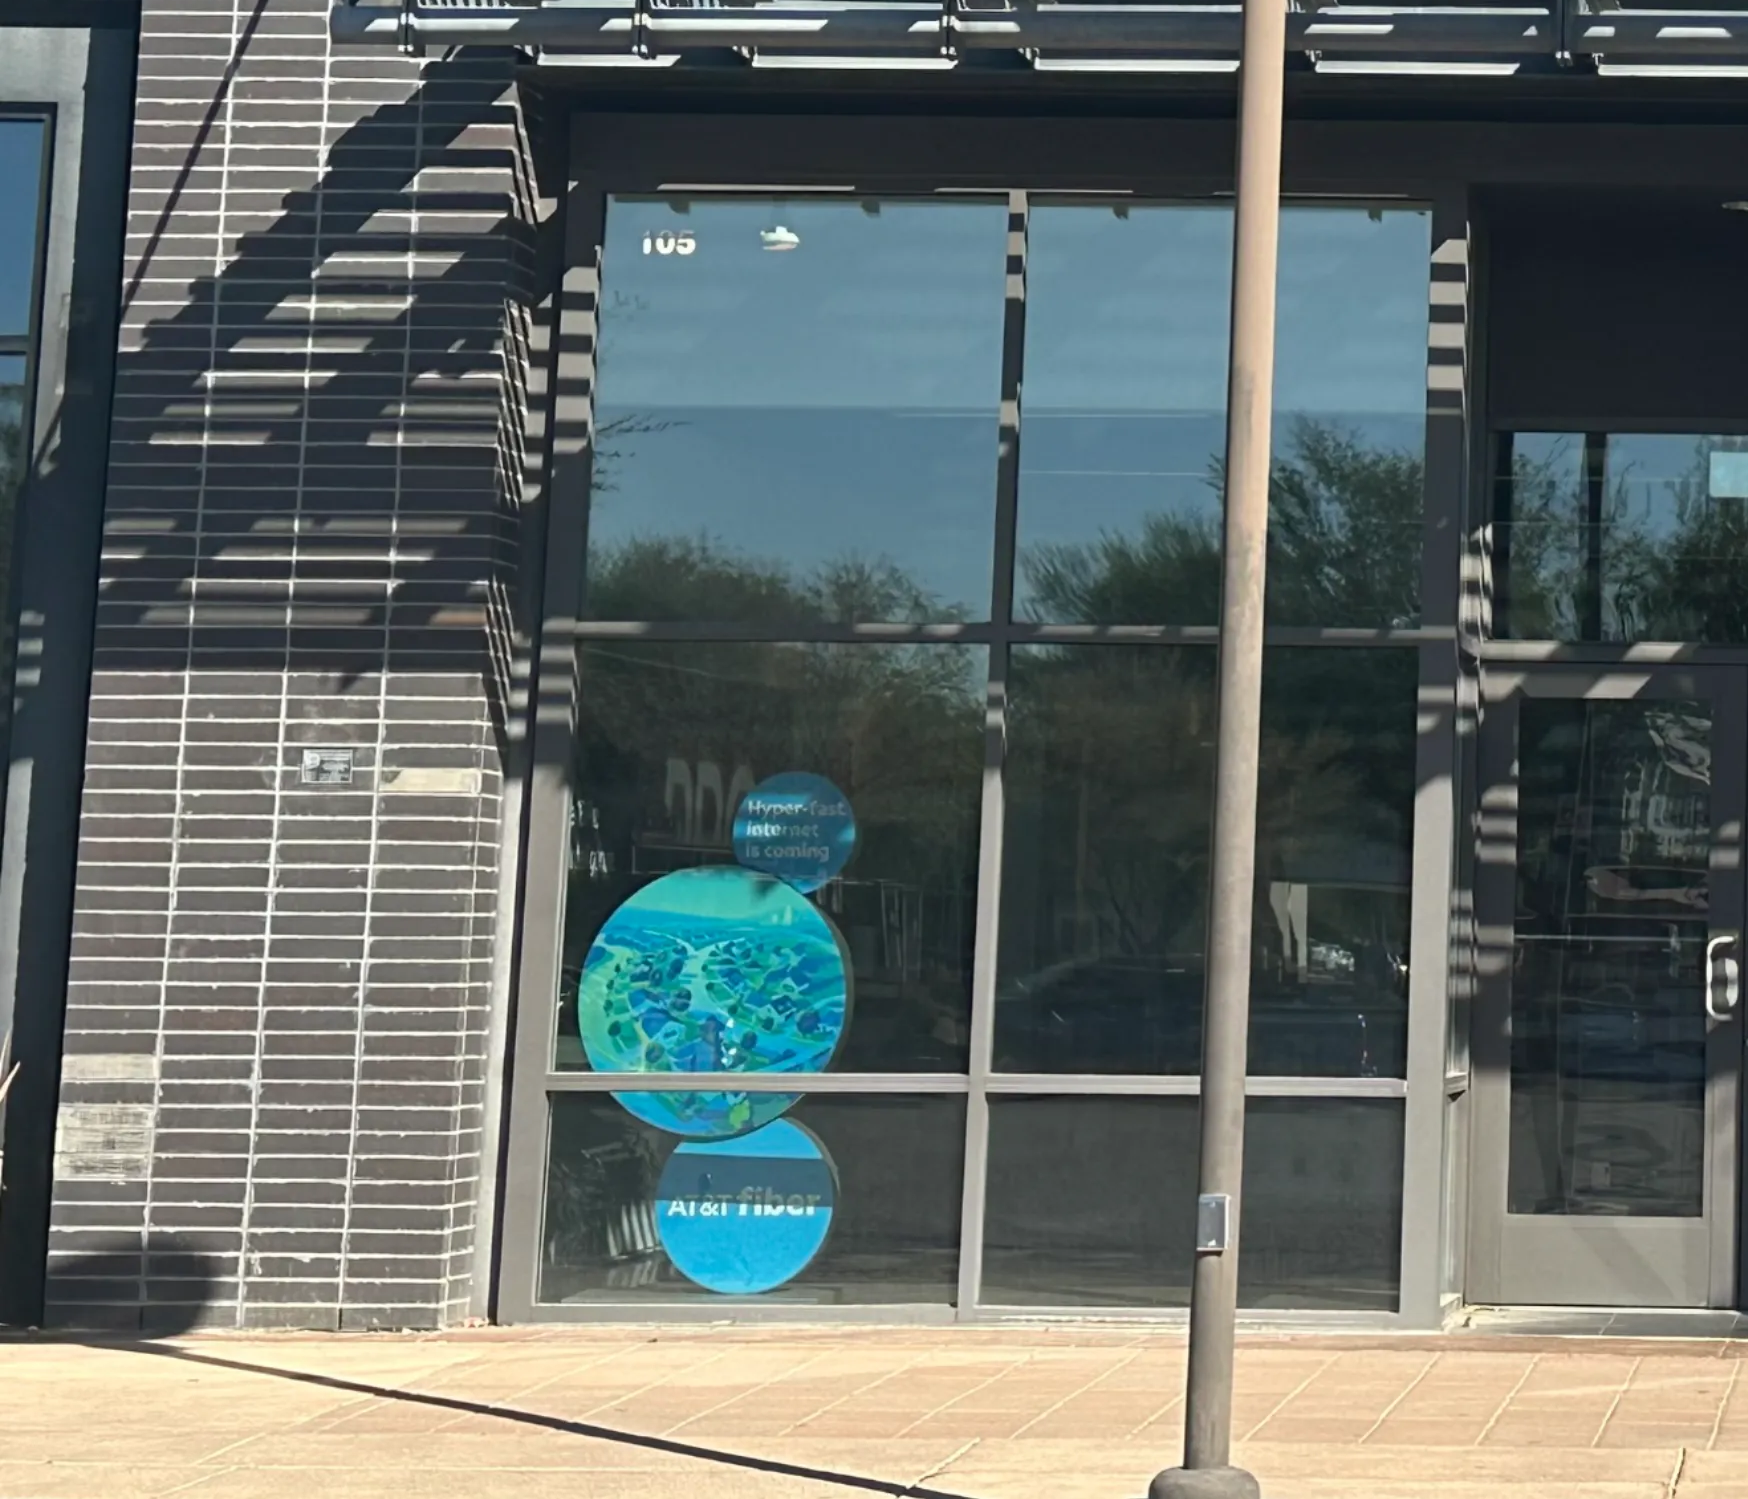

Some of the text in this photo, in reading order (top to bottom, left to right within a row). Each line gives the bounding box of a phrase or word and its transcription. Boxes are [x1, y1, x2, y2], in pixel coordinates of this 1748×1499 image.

[642, 229, 697, 255] 105
[748, 800, 847, 819] Hyper-fast
[765, 843, 830, 862] coming
[667, 1185, 822, 1217] AT&T fiber
